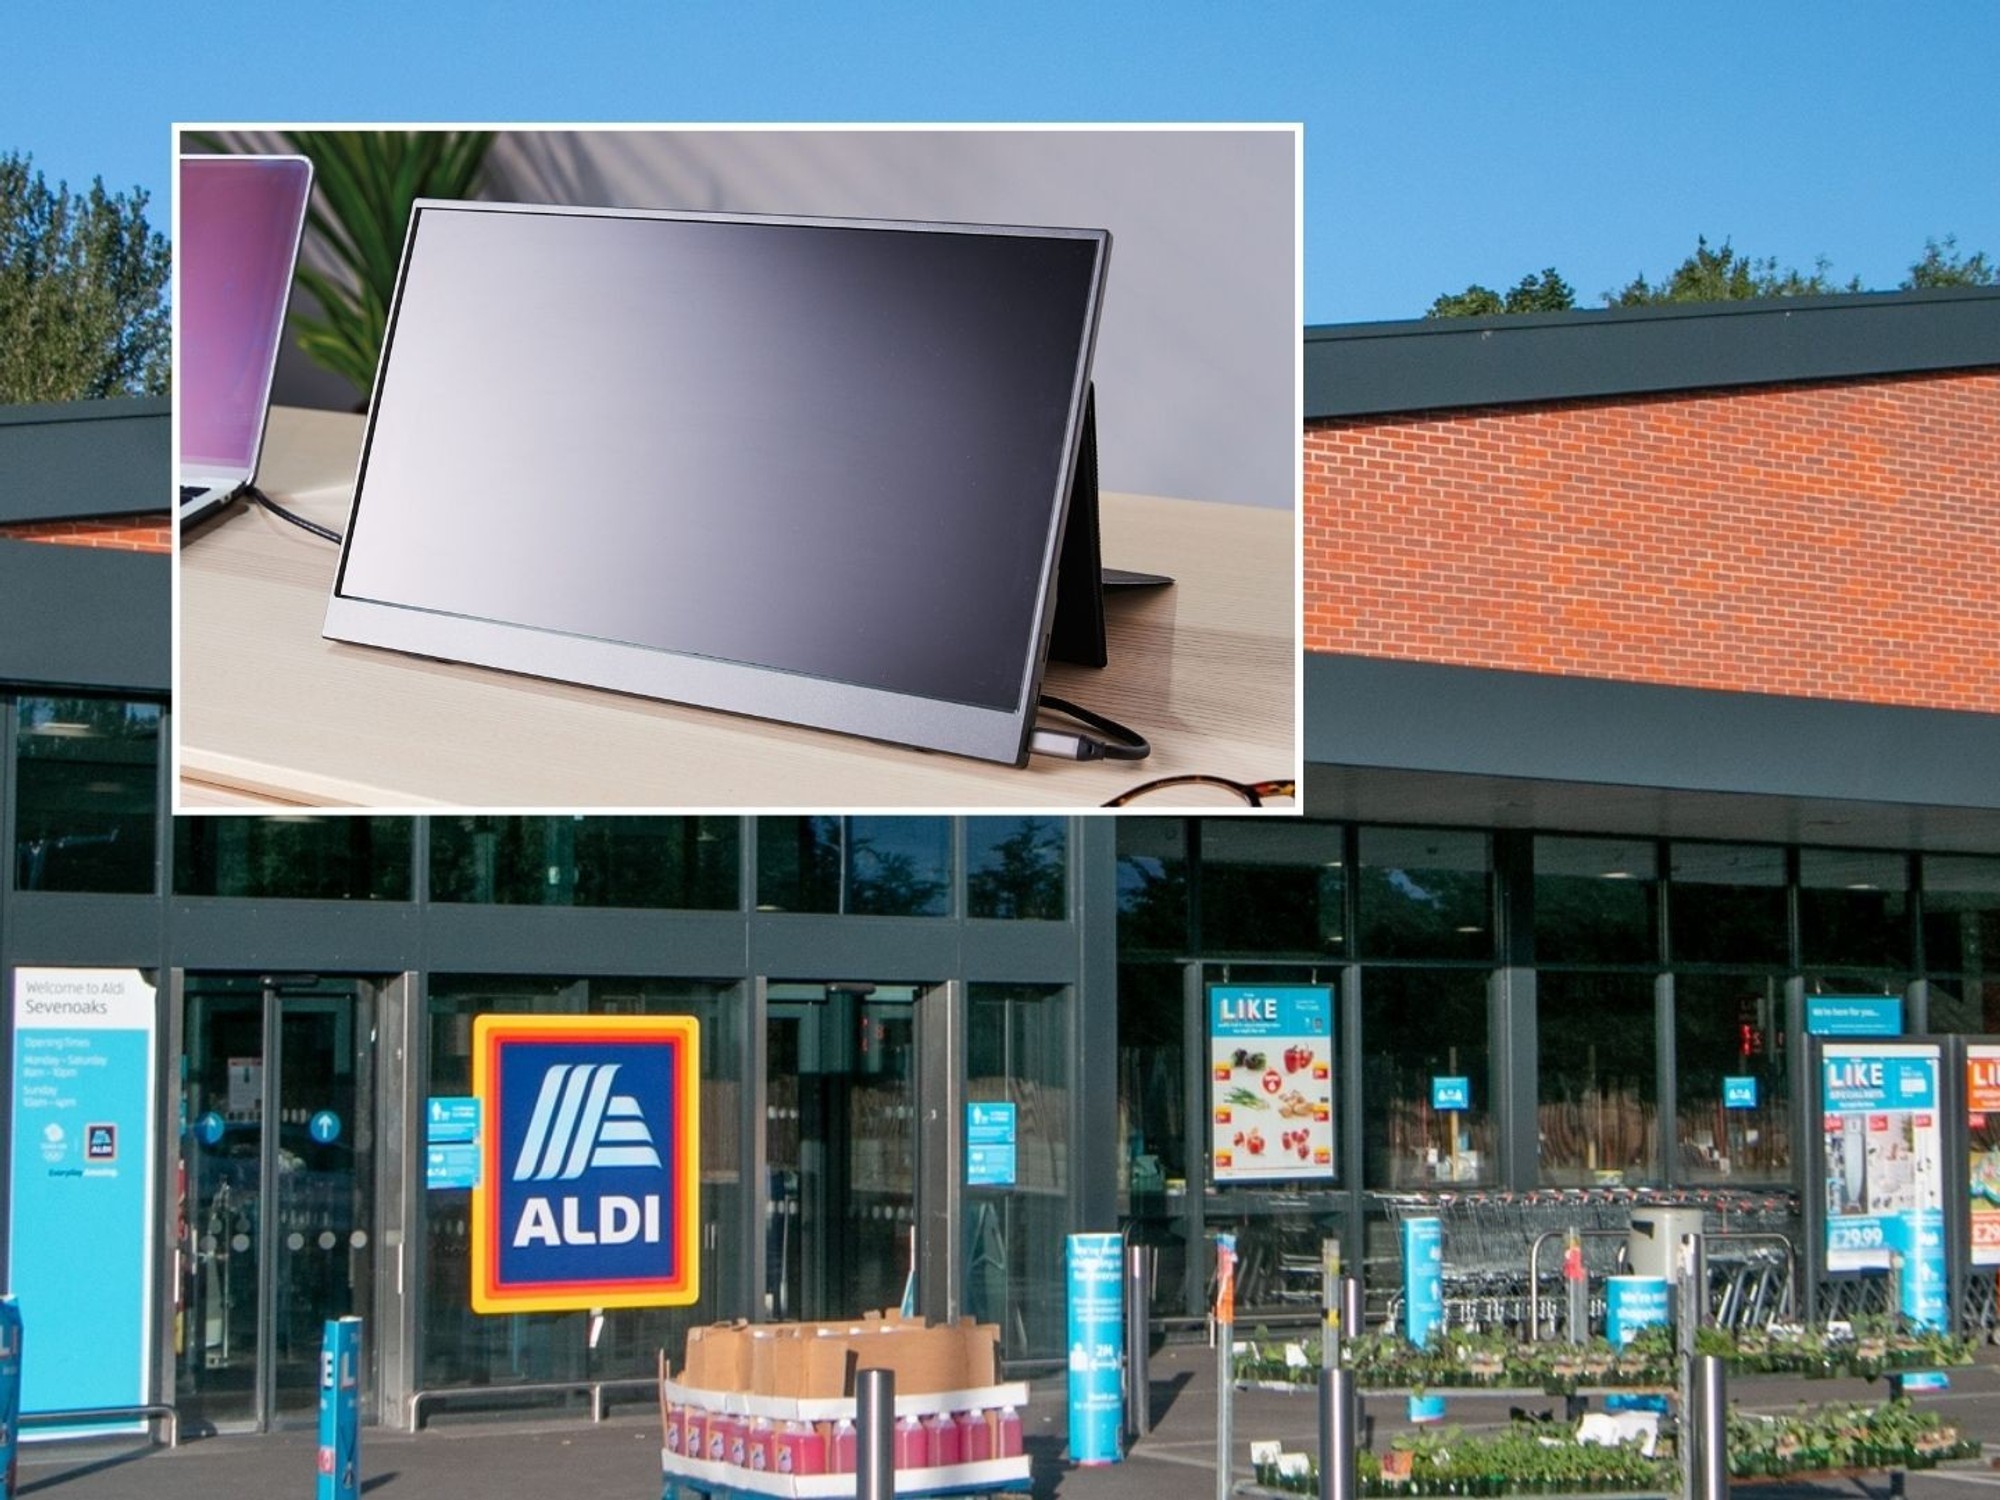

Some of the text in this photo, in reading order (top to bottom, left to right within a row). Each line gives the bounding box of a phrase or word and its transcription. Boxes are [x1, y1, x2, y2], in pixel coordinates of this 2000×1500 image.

[26, 981, 124, 995] Welcome to Aldi
[26, 1000, 107, 1015] Sevenoaks
[1221, 998, 1278, 1021] LIKE
[1828, 1063, 1884, 1088] LIKE
[513, 1195, 660, 1248] ALDI
